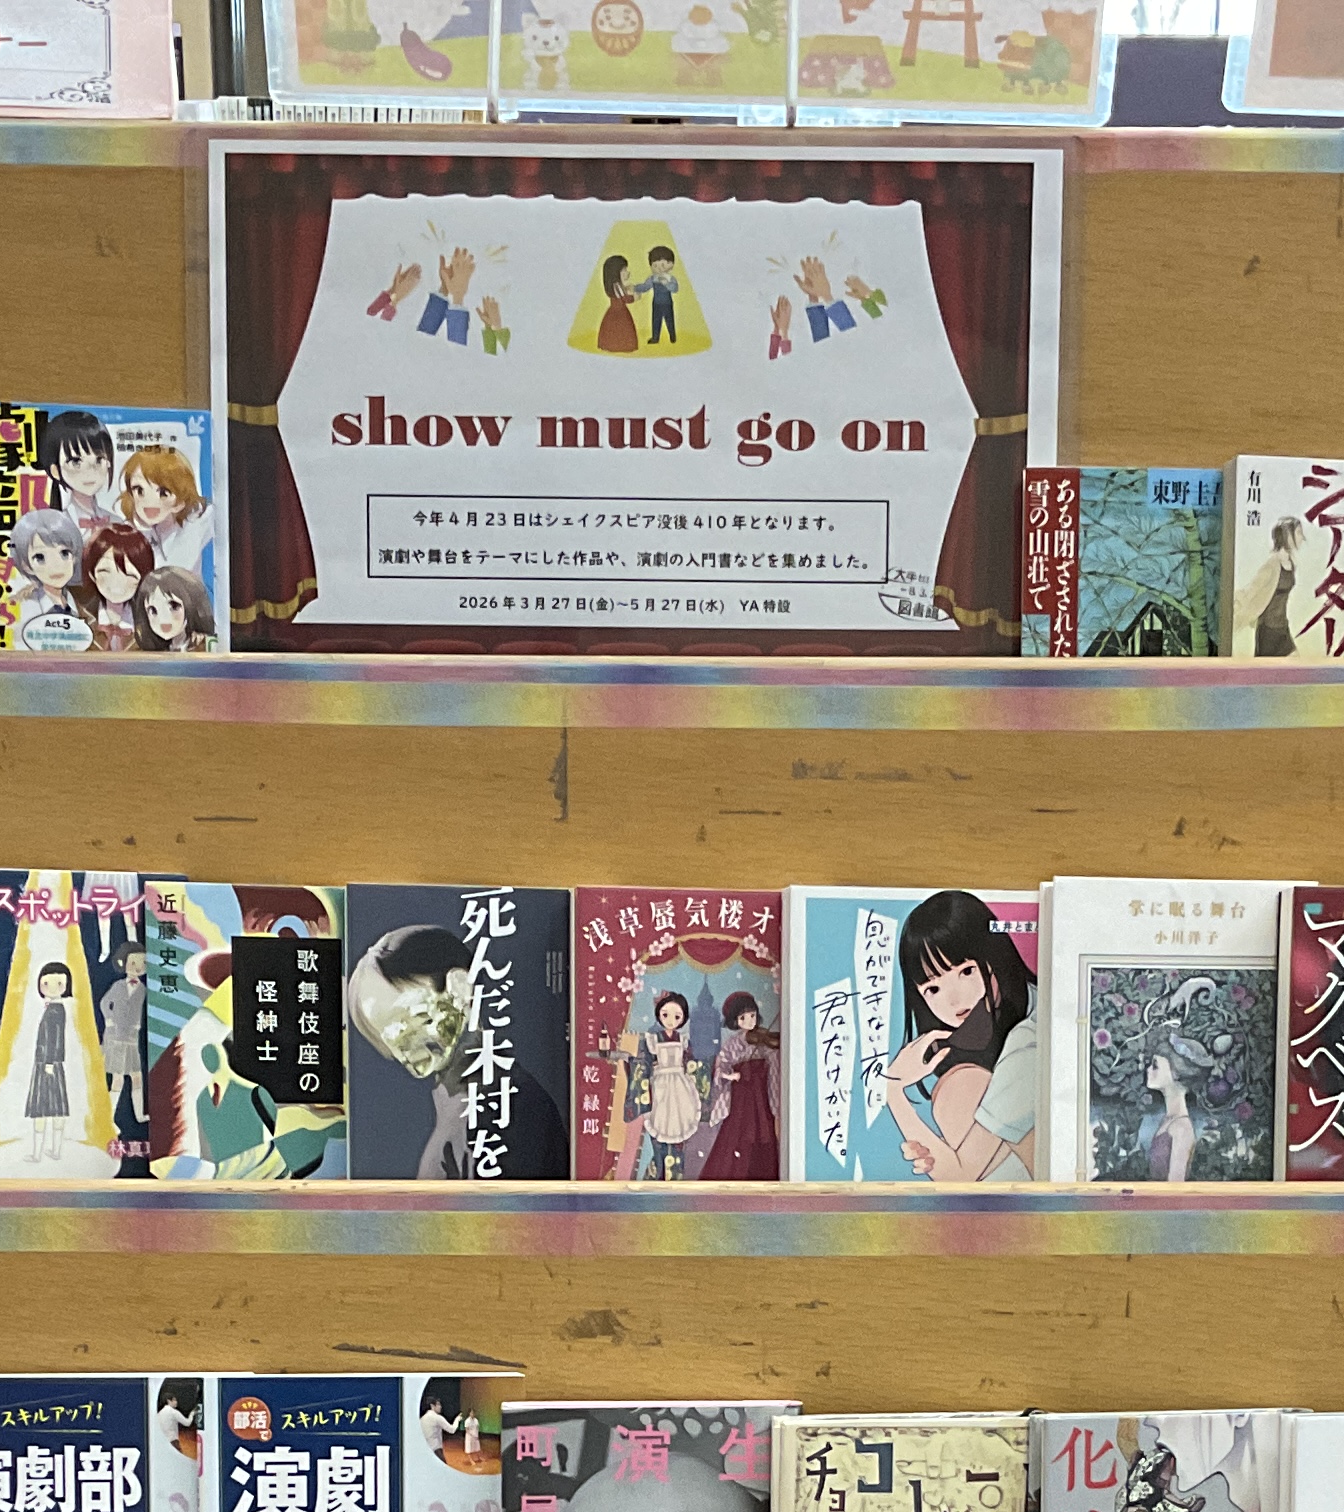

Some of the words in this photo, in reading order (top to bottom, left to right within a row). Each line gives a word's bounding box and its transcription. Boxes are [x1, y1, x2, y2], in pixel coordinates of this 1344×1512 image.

[331, 396, 512, 447] show
[537, 404, 712, 452] must
[736, 412, 816, 468] go
[841, 417, 929, 453] on
[157, 892, 179, 995] 近藤史恵
[1154, 929, 1220, 946] 小川洋子
[255, 979, 280, 1063] 怪紳士
[296, 948, 321, 1093] 歌舞伎座の
[459, 886, 519, 1178] 死んだ木村を
